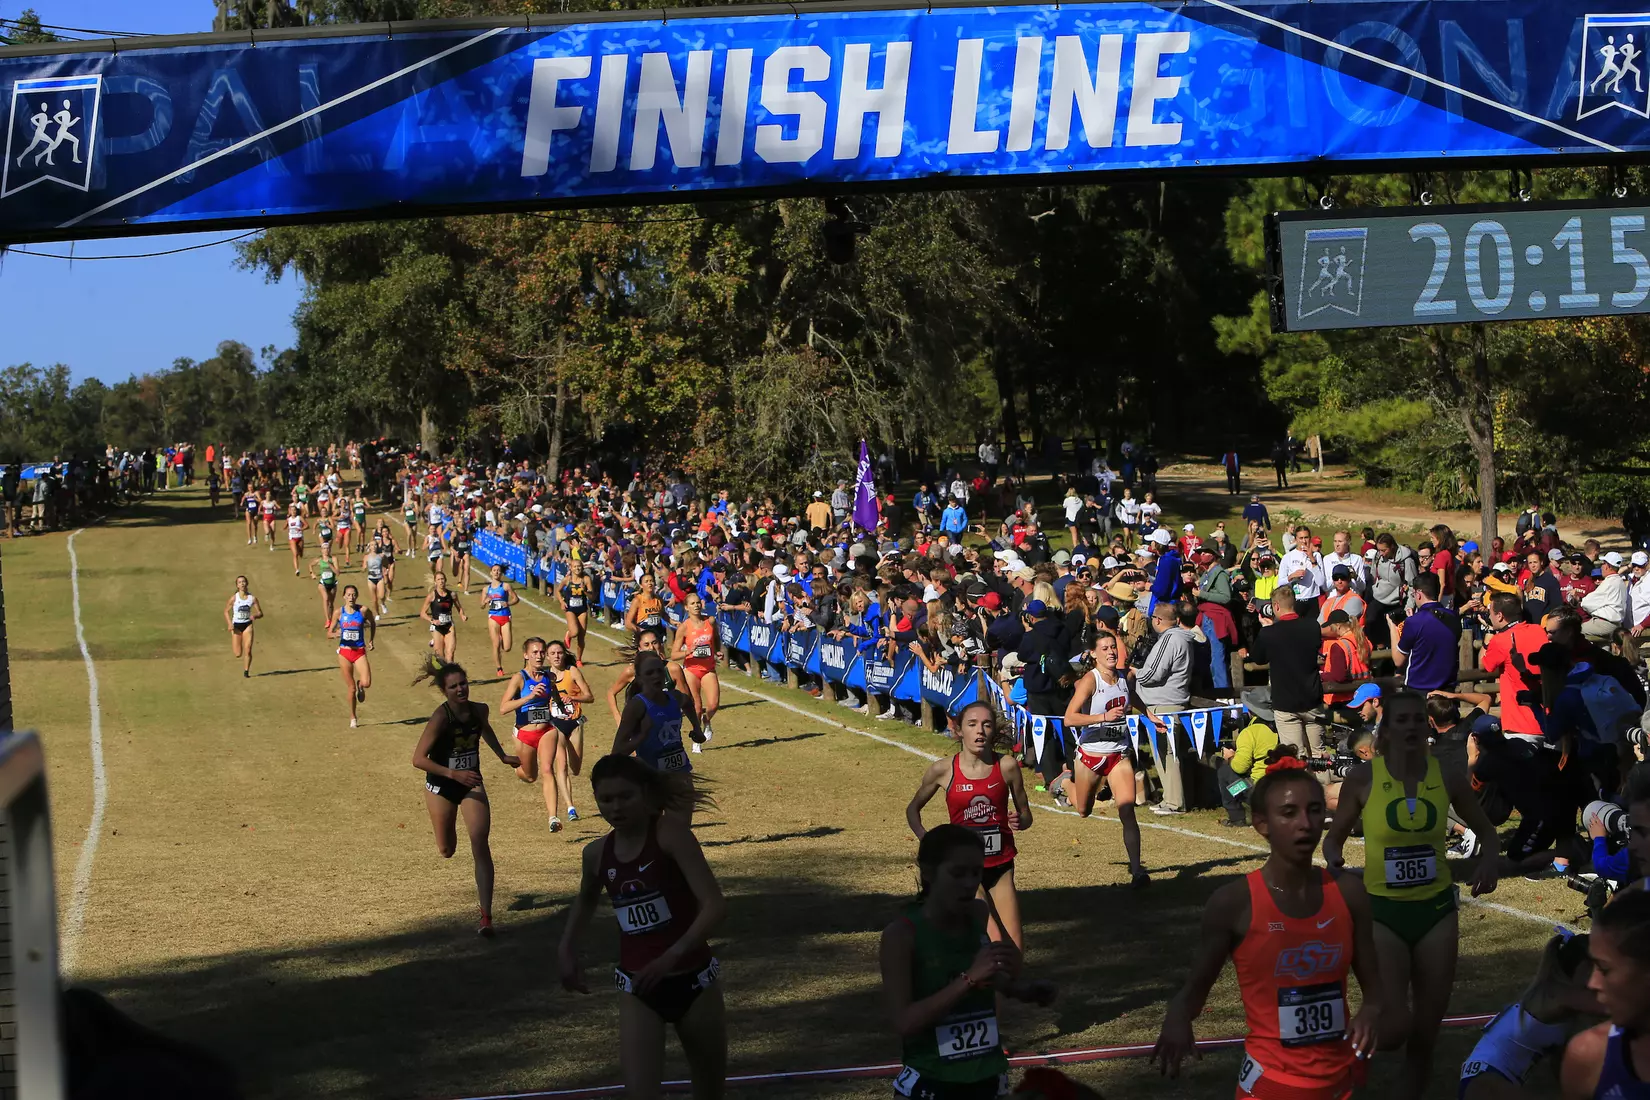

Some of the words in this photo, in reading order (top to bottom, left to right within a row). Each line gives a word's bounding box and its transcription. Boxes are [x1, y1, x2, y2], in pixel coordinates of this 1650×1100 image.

[521, 41, 913, 178] FINISH
[946, 31, 1191, 155] LINE
[1408, 215, 1650, 317] 20:15
[531, 710, 547, 721] 351
[1105, 726, 1123, 738] 494
[455, 756, 472, 769] 231
[664, 754, 683, 770] 299
[1395, 859, 1427, 881] 365
[628, 902, 660, 927] 408
[1294, 1003, 1333, 1035] 339
[950, 1020, 990, 1051] 322
